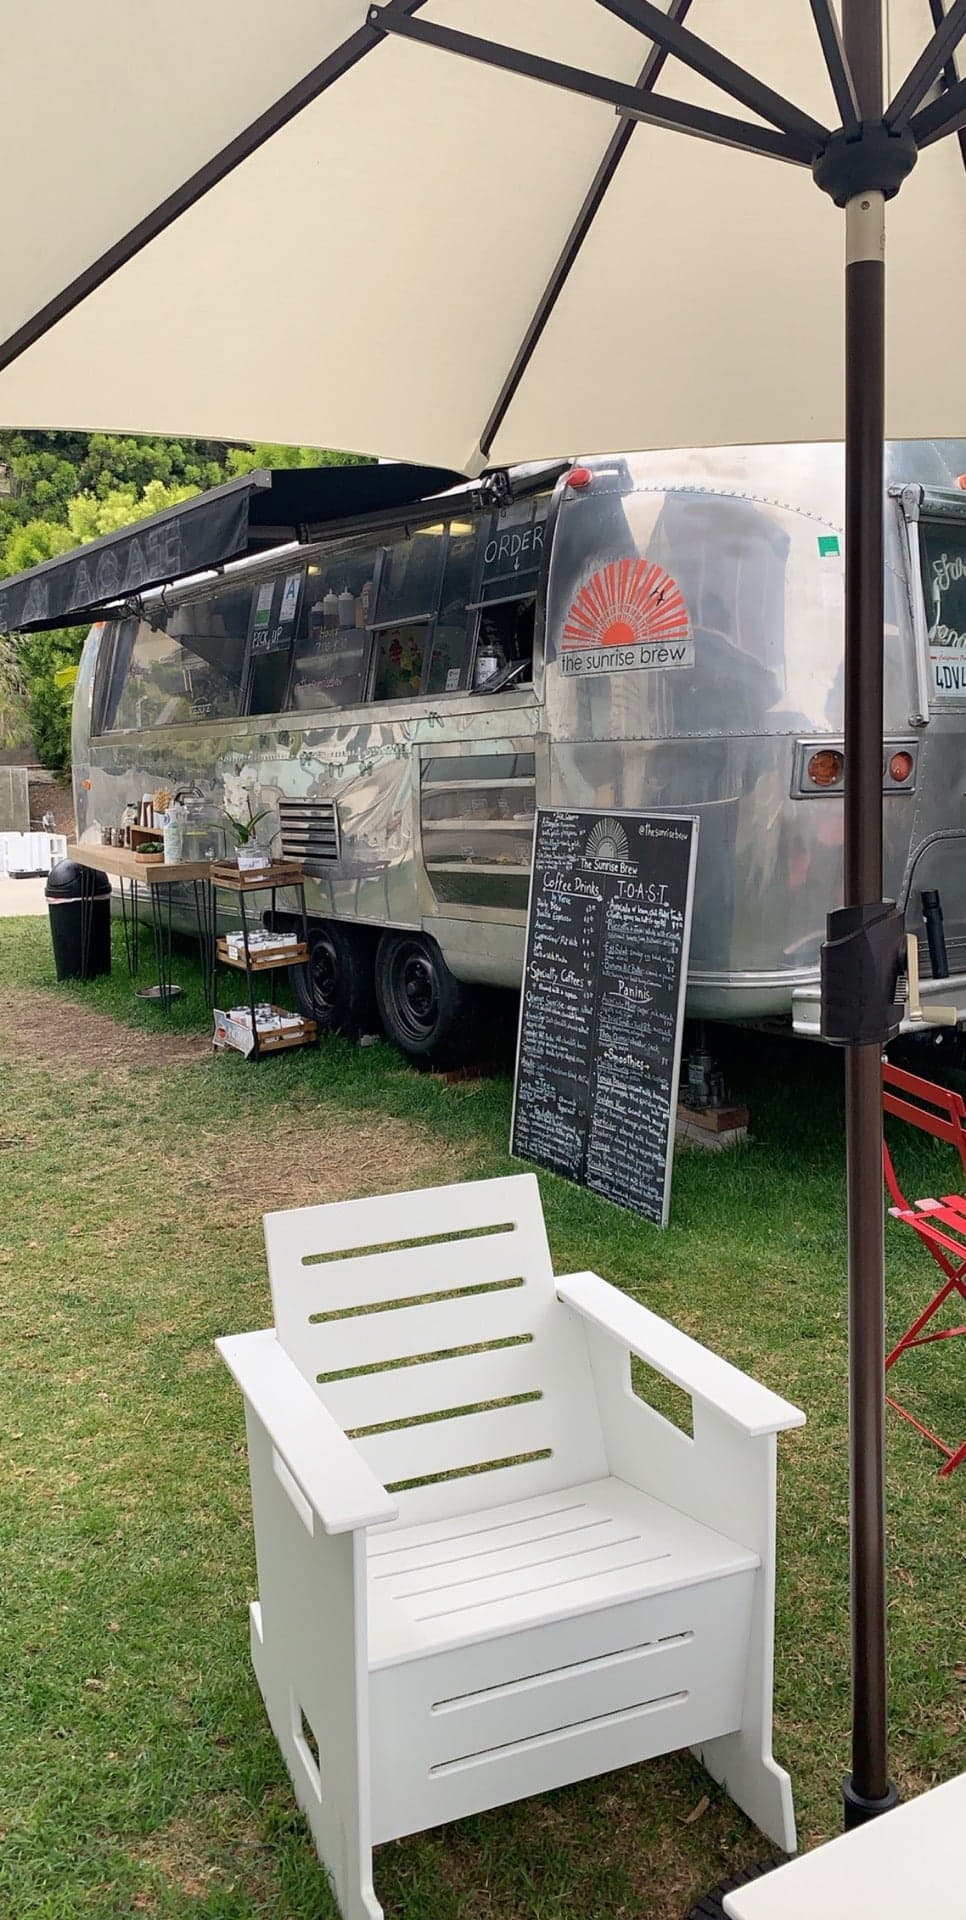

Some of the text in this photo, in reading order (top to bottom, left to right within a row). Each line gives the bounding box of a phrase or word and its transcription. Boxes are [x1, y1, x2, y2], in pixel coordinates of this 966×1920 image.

[484, 526, 545, 564] ORDER
[286, 578, 296, 599] A
[561, 645, 686, 673] the sunrise brew
[581, 859, 638, 875] The Sunrise Brew
[543, 872, 600, 896] Coffee Drinks
[560, 968, 584, 988] Coffees
[618, 980, 650, 999] Paninis
[608, 1048, 644, 1070] Smoothies
